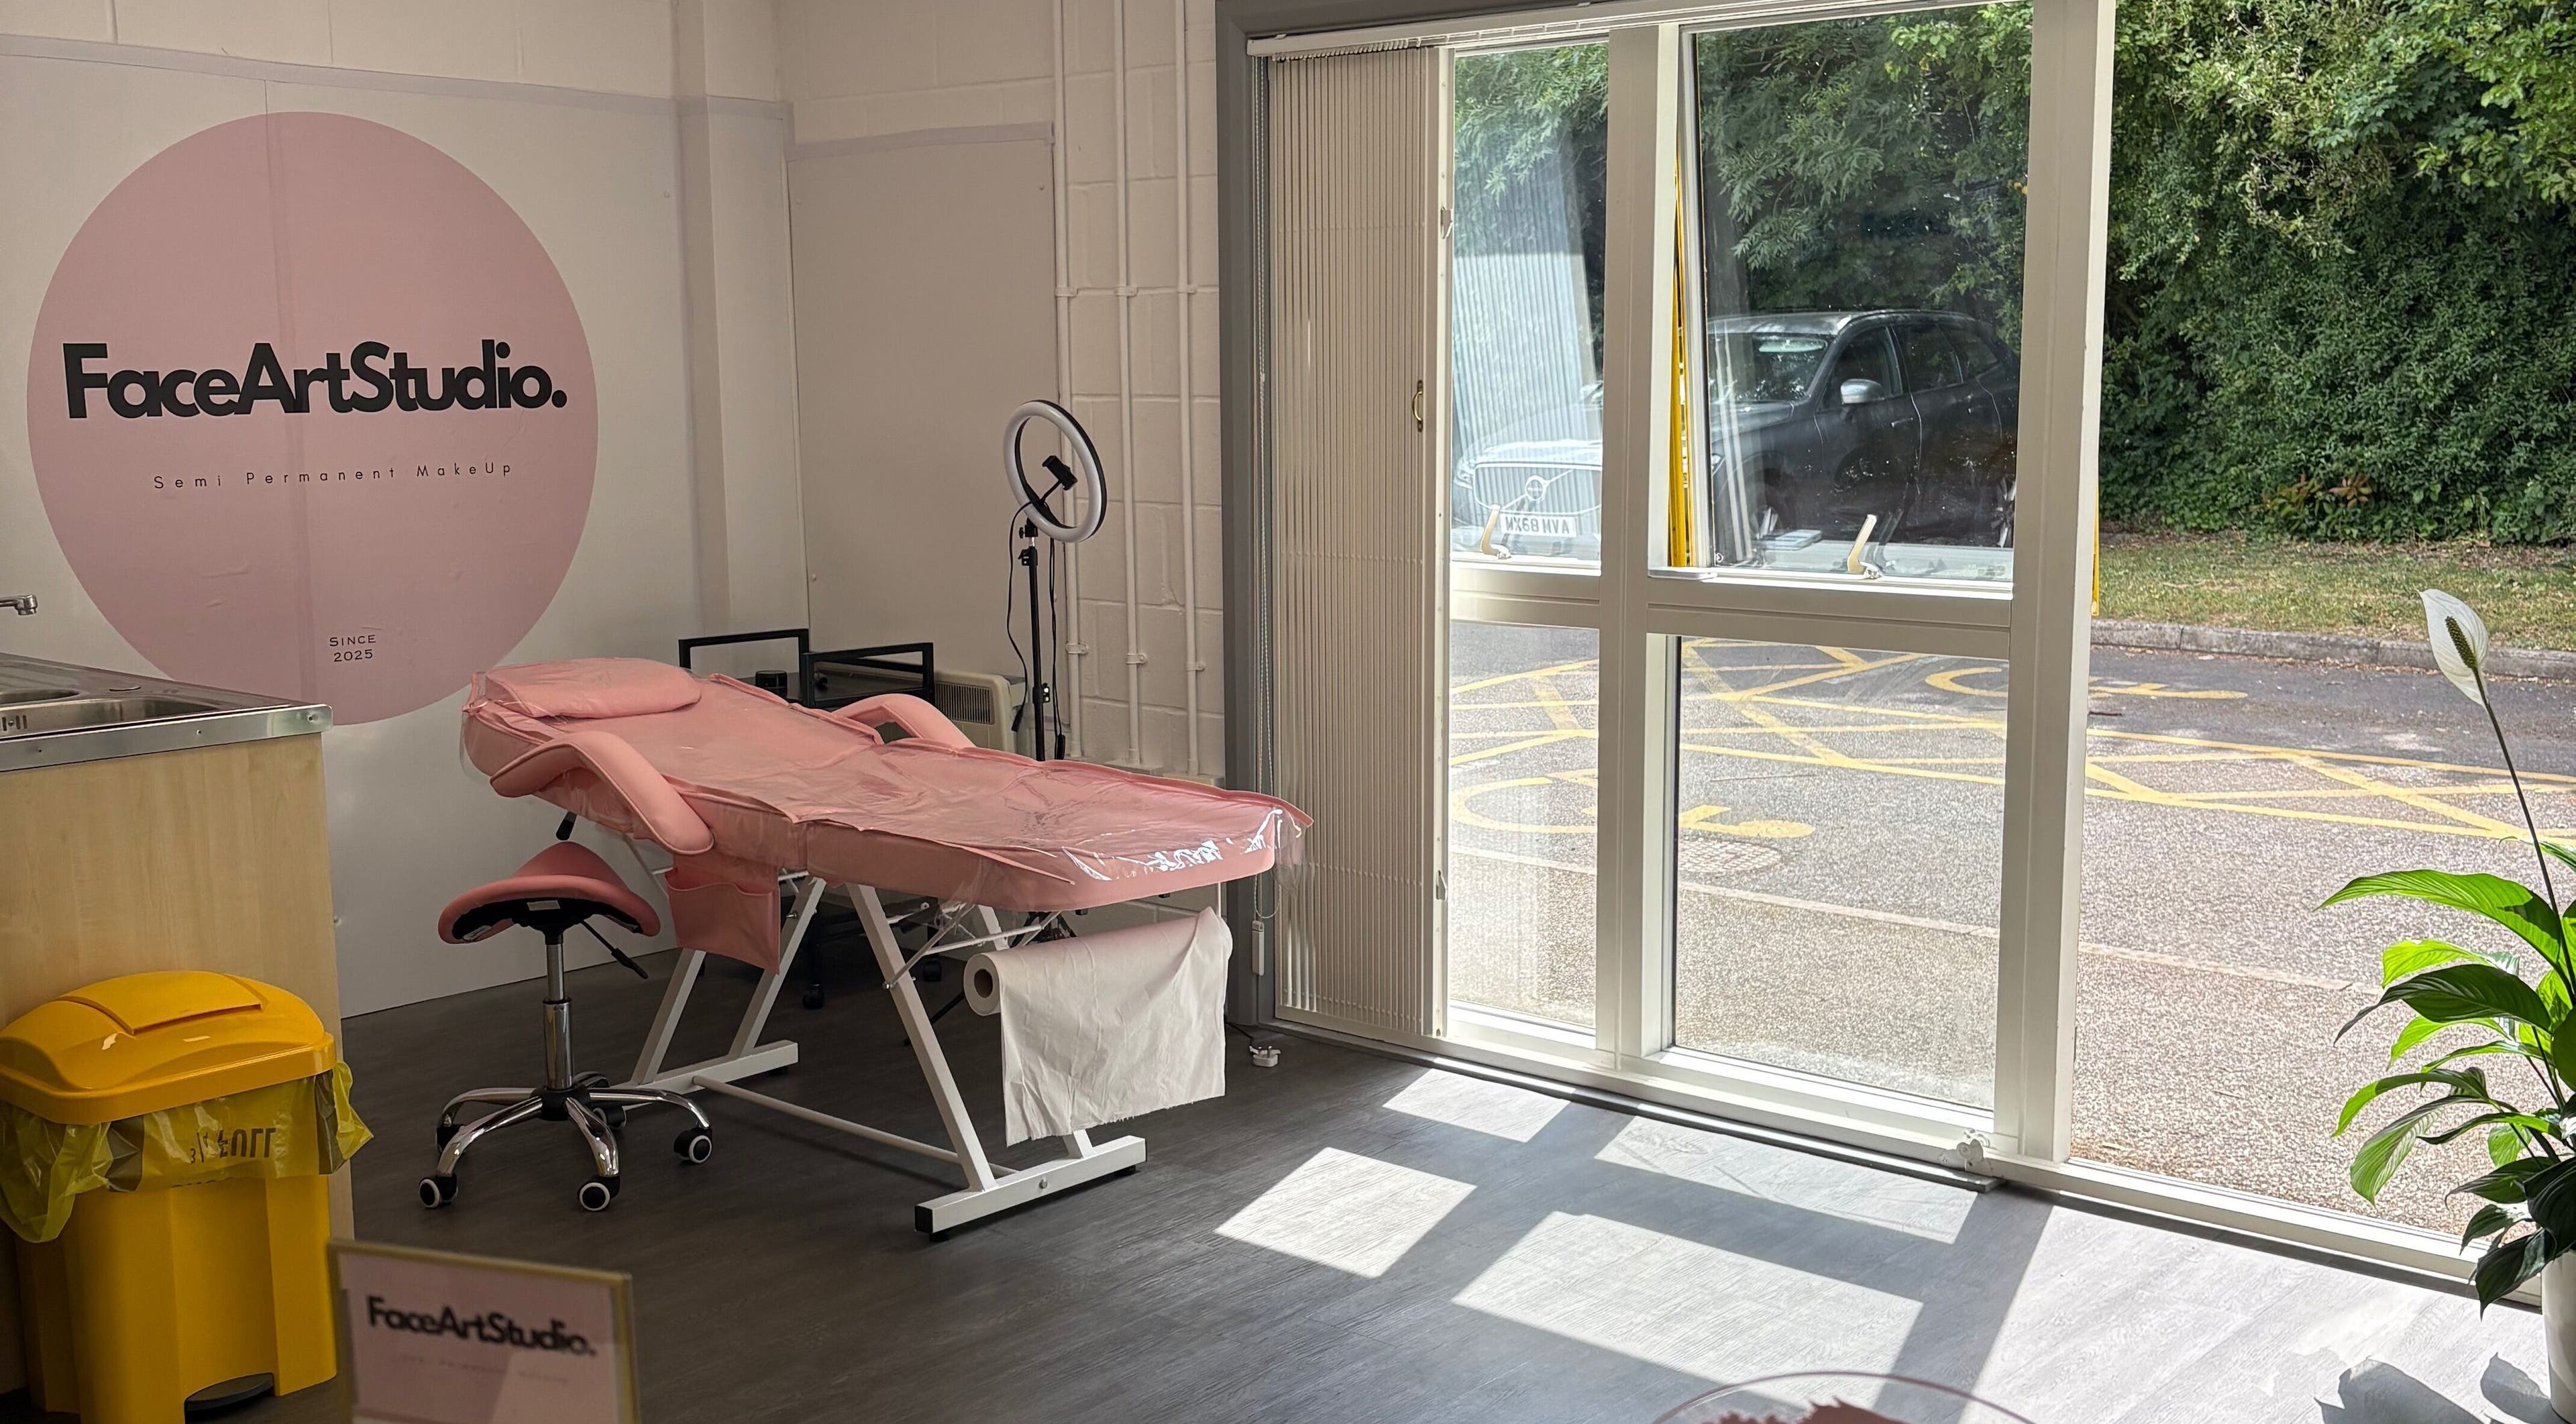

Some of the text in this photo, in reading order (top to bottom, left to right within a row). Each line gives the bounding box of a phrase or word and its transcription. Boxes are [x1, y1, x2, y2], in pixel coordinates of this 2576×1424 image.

[62, 339, 568, 419] FaceArtStudio.
[154, 461, 511, 489] Semi Permanent MakeUp
[1542, 518, 1570, 535] MVA
[329, 635, 376, 647] SINCE
[333, 649, 373, 663] 2025
[366, 1293, 598, 1358] FaceArtStudio.
